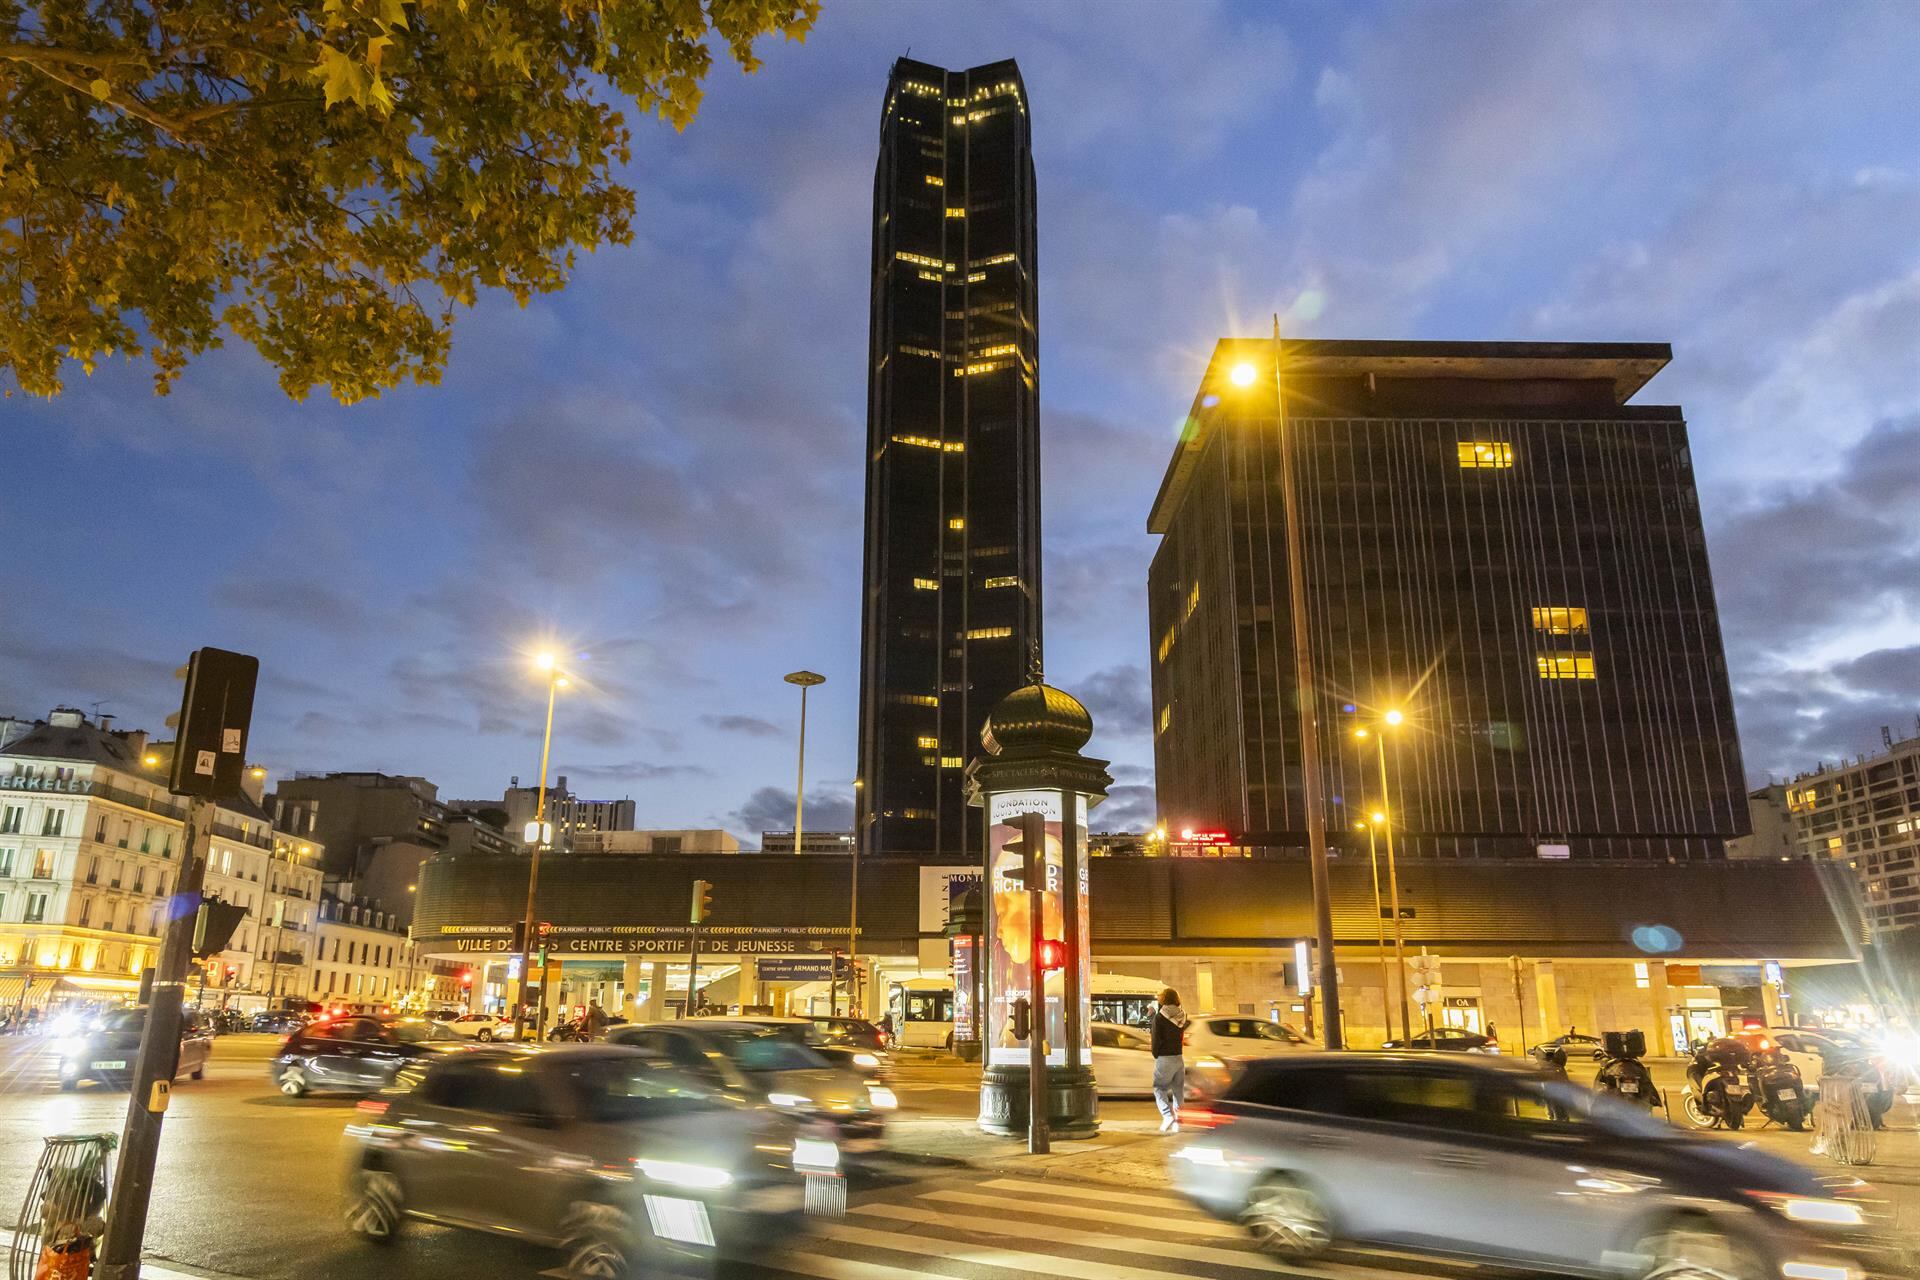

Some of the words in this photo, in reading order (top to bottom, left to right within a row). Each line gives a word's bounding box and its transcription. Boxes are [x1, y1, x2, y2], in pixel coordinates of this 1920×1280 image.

[993, 878, 1058, 893] RICHR
[457, 939, 492, 951] VILLE
[570, 940, 623, 951] CENTRE
[629, 940, 685, 952] SPORTIF
[712, 941, 729, 951] DE
[734, 941, 795, 952] JEUNESSE
